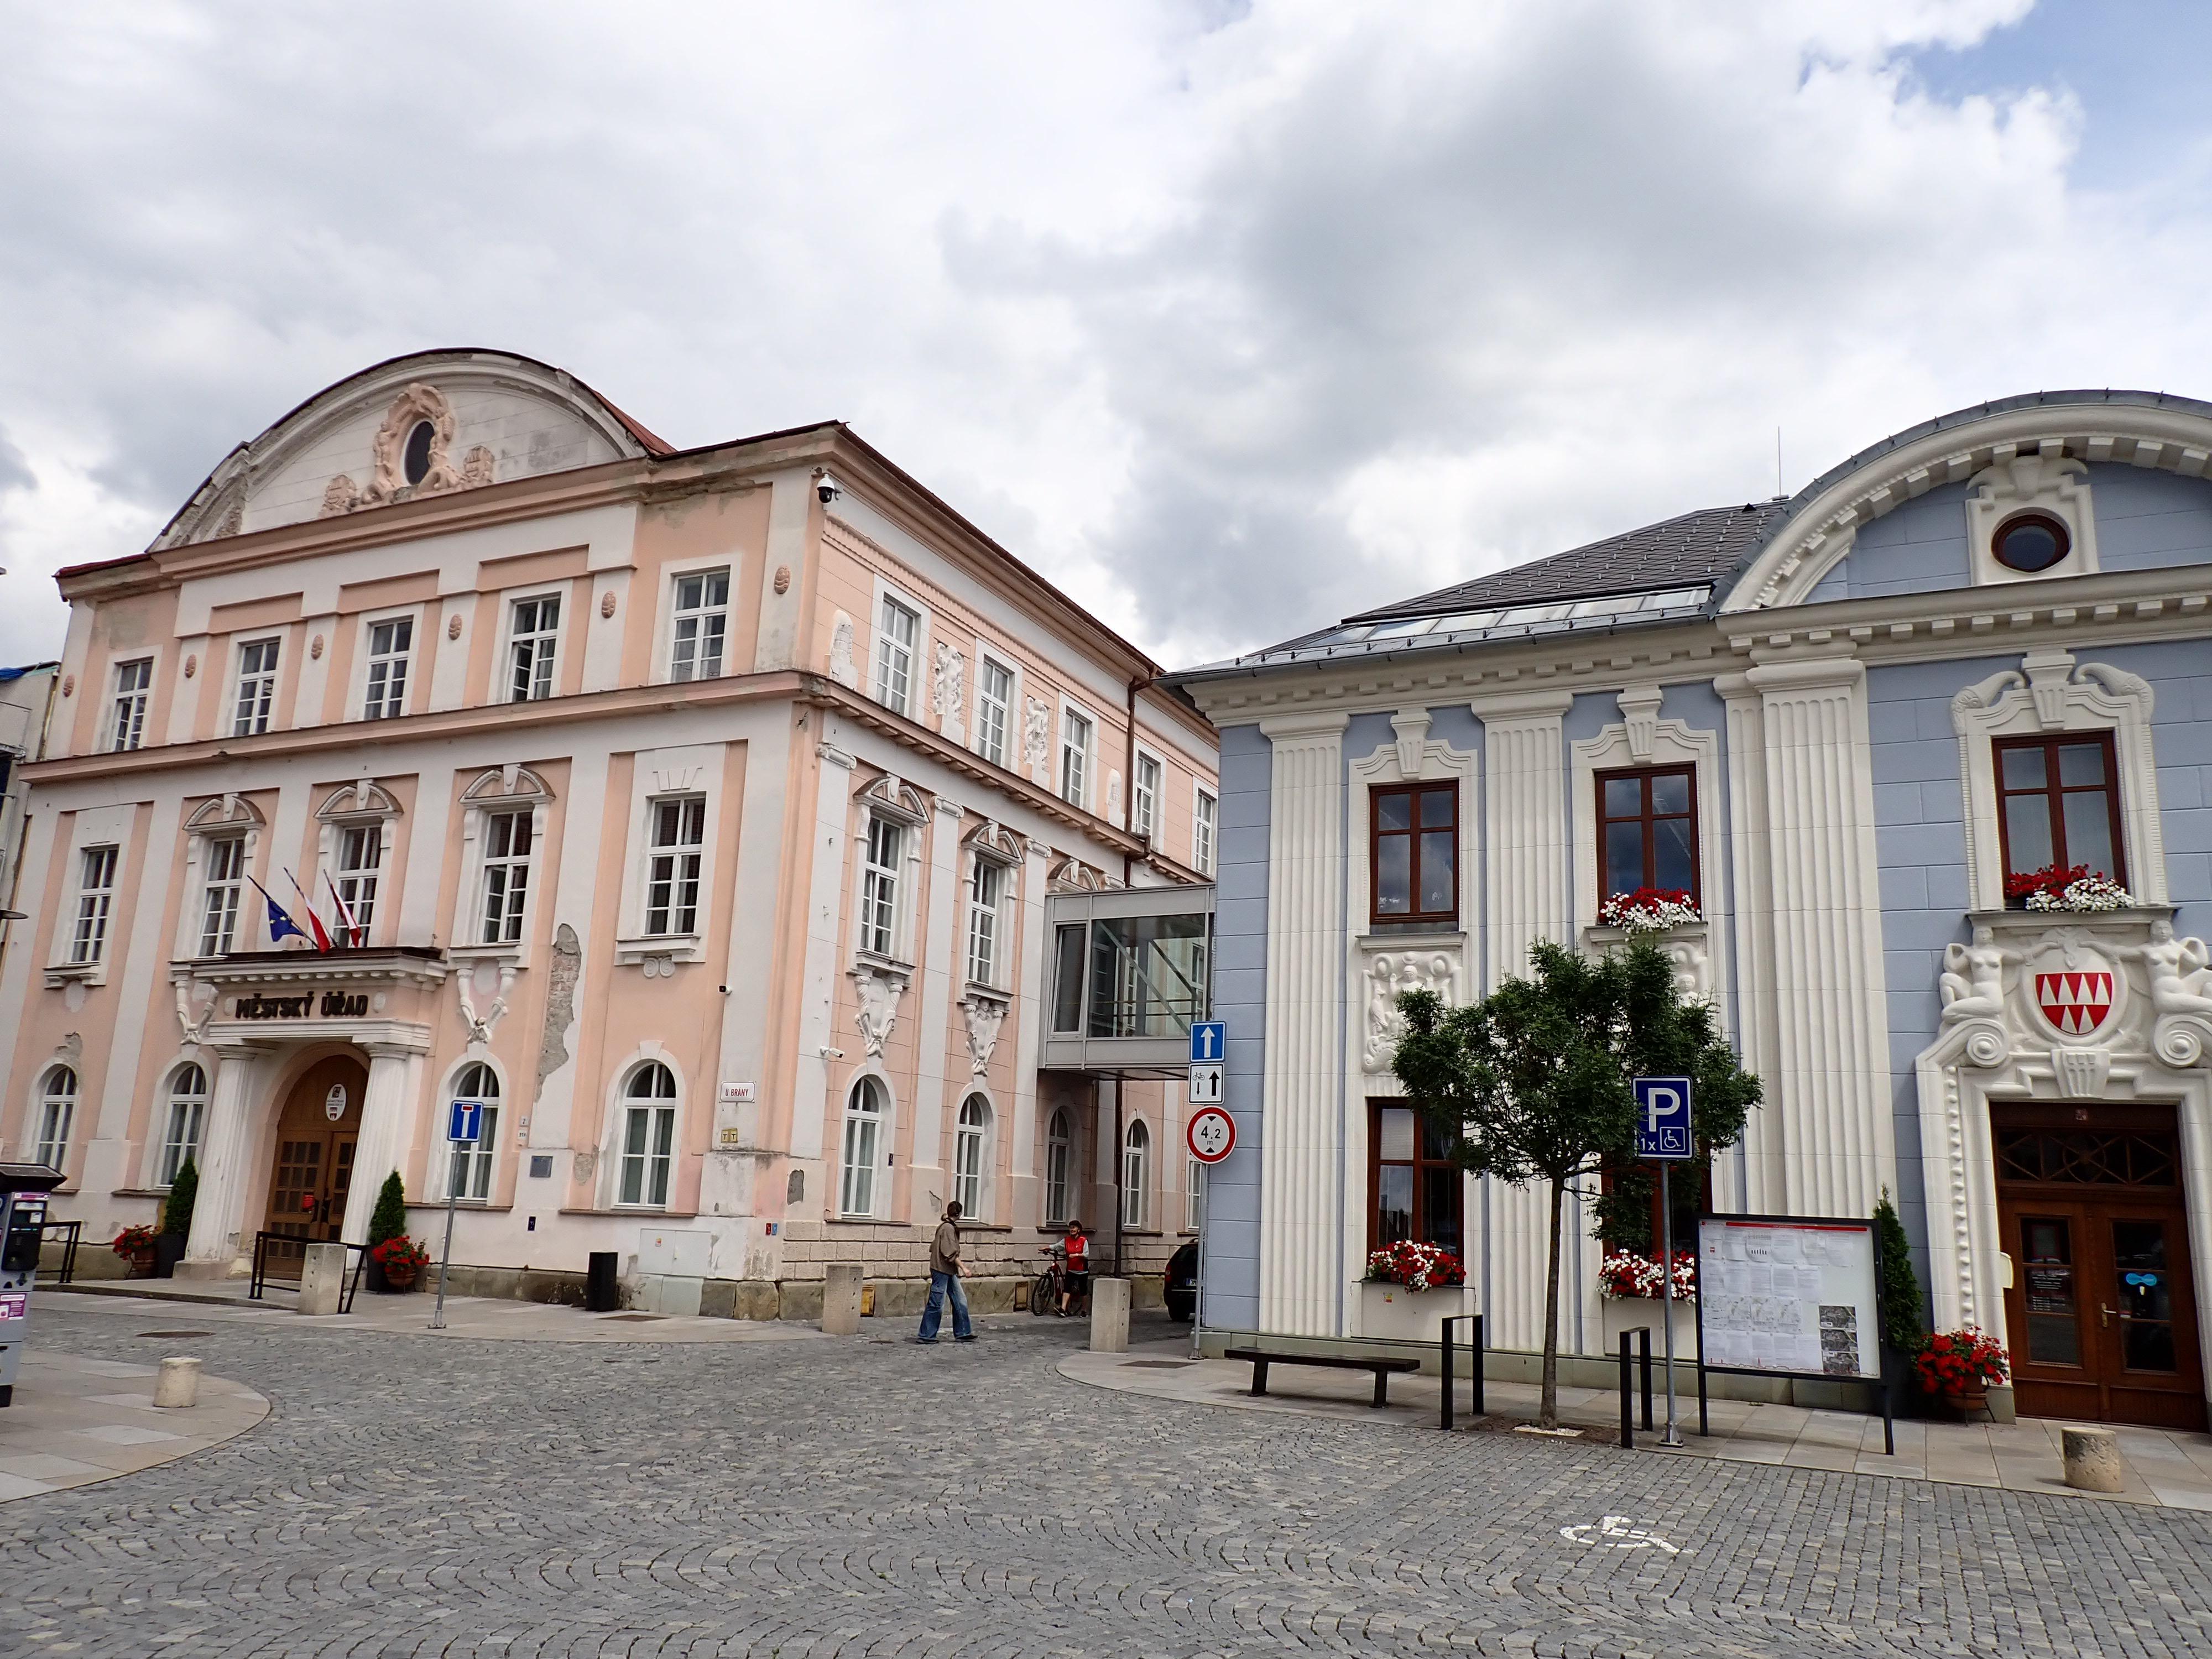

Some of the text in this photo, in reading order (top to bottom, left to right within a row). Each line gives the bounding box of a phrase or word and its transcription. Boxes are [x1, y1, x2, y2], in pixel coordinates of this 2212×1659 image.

[236, 991, 368, 1019] MĚSTSKÝ ÚŘAD
[731, 1087, 749, 1096] BRÁNY
[1648, 1088, 1680, 1132] P
[1201, 1125, 1220, 1139] 4,2
[1640, 1138, 1656, 1151] 1x
